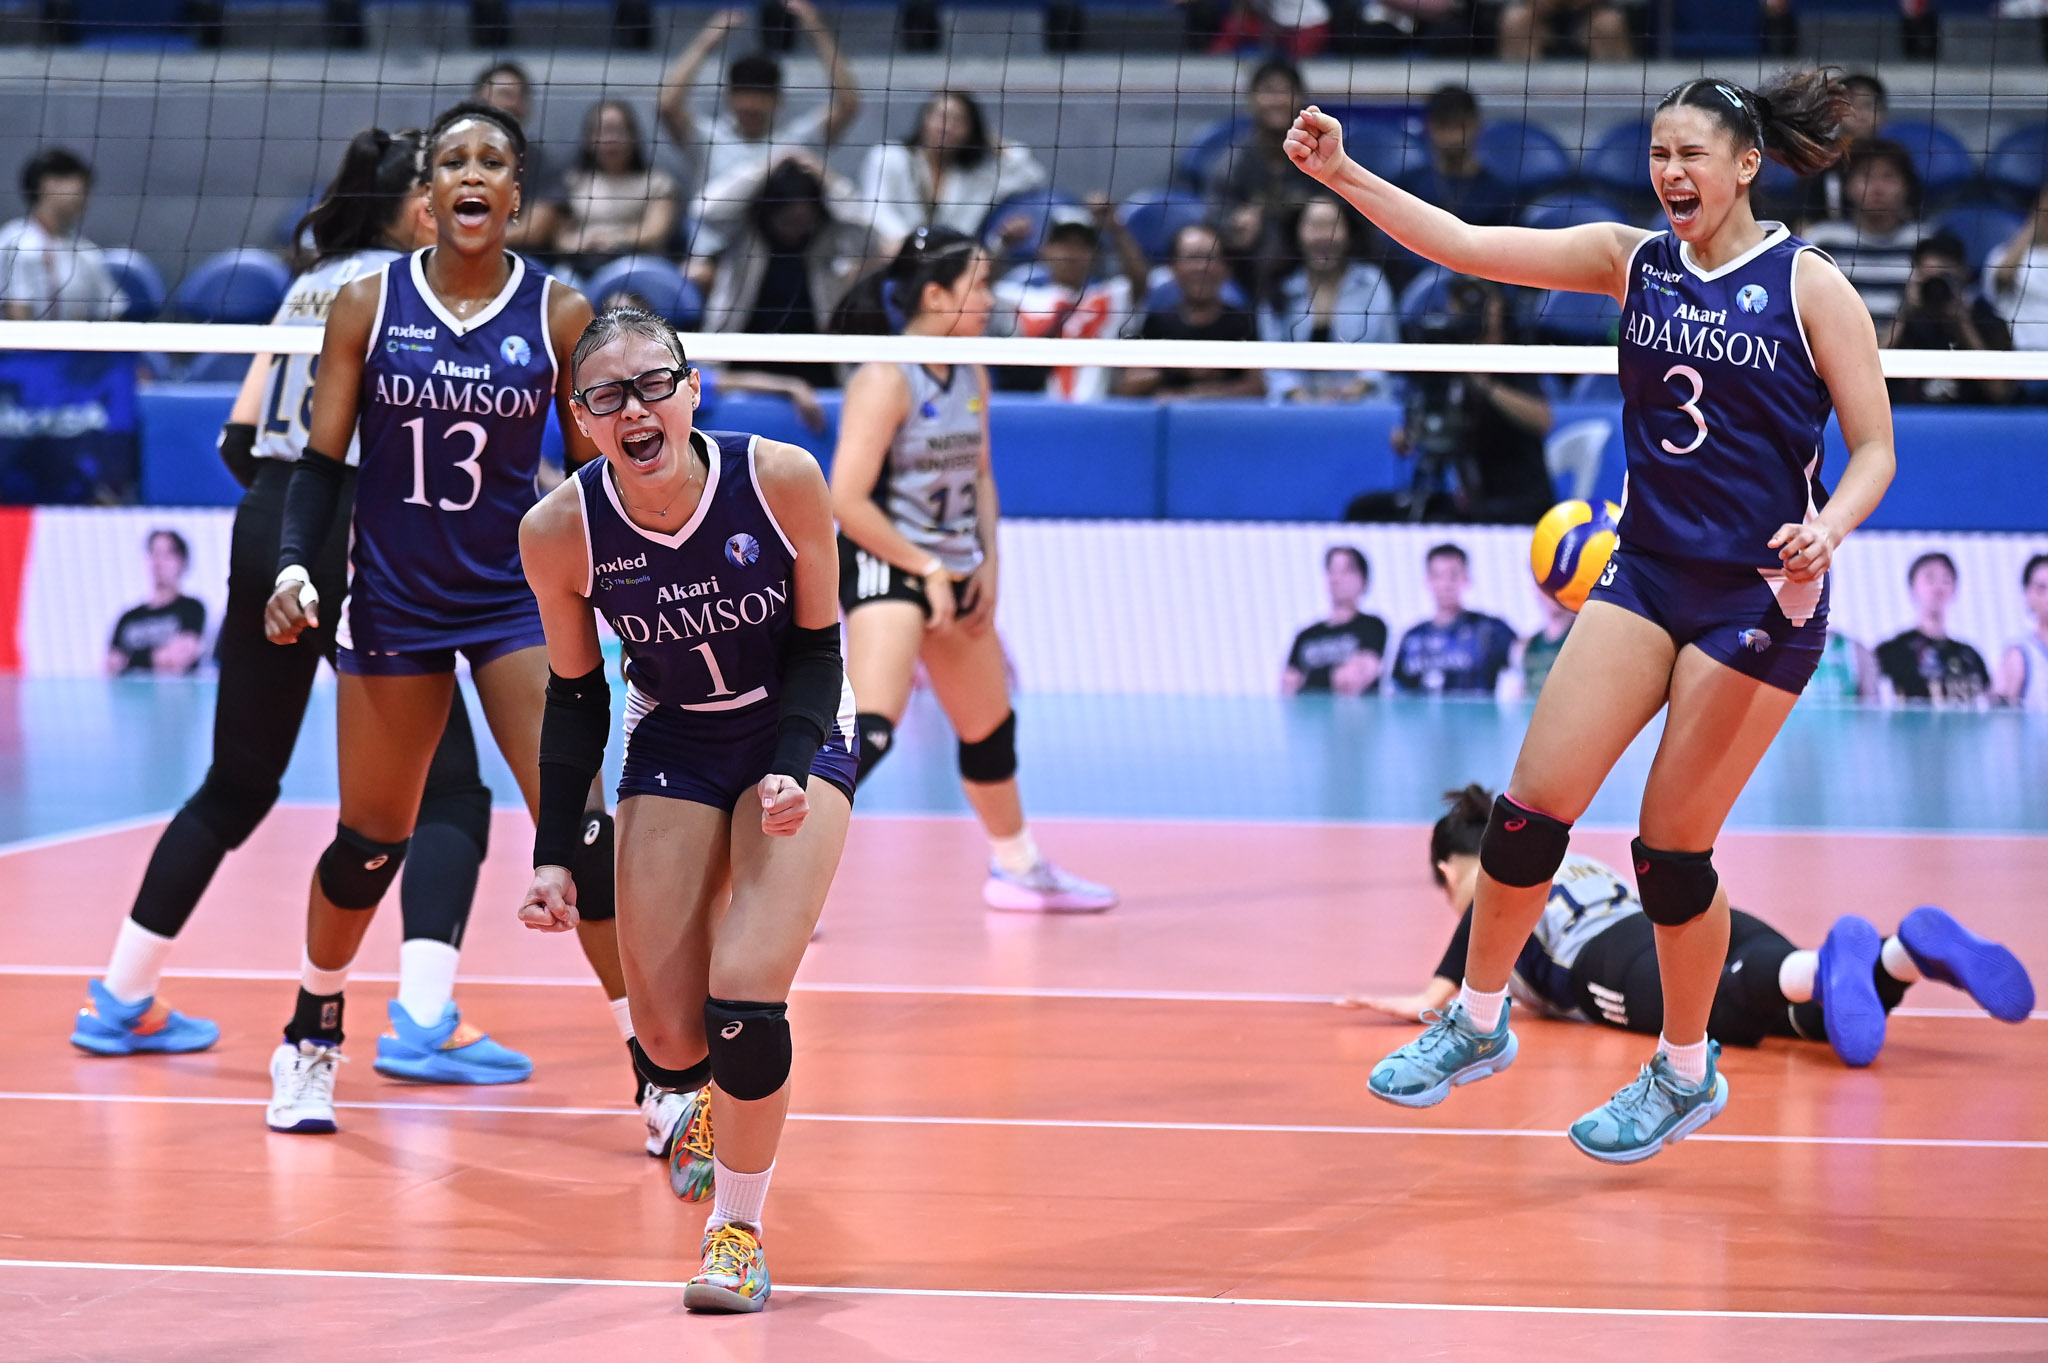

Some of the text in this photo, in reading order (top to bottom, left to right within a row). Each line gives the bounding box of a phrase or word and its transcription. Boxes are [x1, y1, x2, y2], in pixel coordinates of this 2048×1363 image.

[1673, 303, 1728, 326] Akari
[387, 323, 437, 340] nxled
[1625, 310, 1782, 373] ADAMSON
[432, 359, 491, 380] Akari
[375, 373, 542, 419] ADAMSON
[1661, 364, 1709, 454] 3
[401, 416, 489, 512] 13
[594, 552, 648, 576] nxled
[1600, 561, 1619, 587] 3
[614, 575, 651, 586] The Biopolis
[656, 575, 721, 605] Akari
[689, 641, 737, 697] 1
